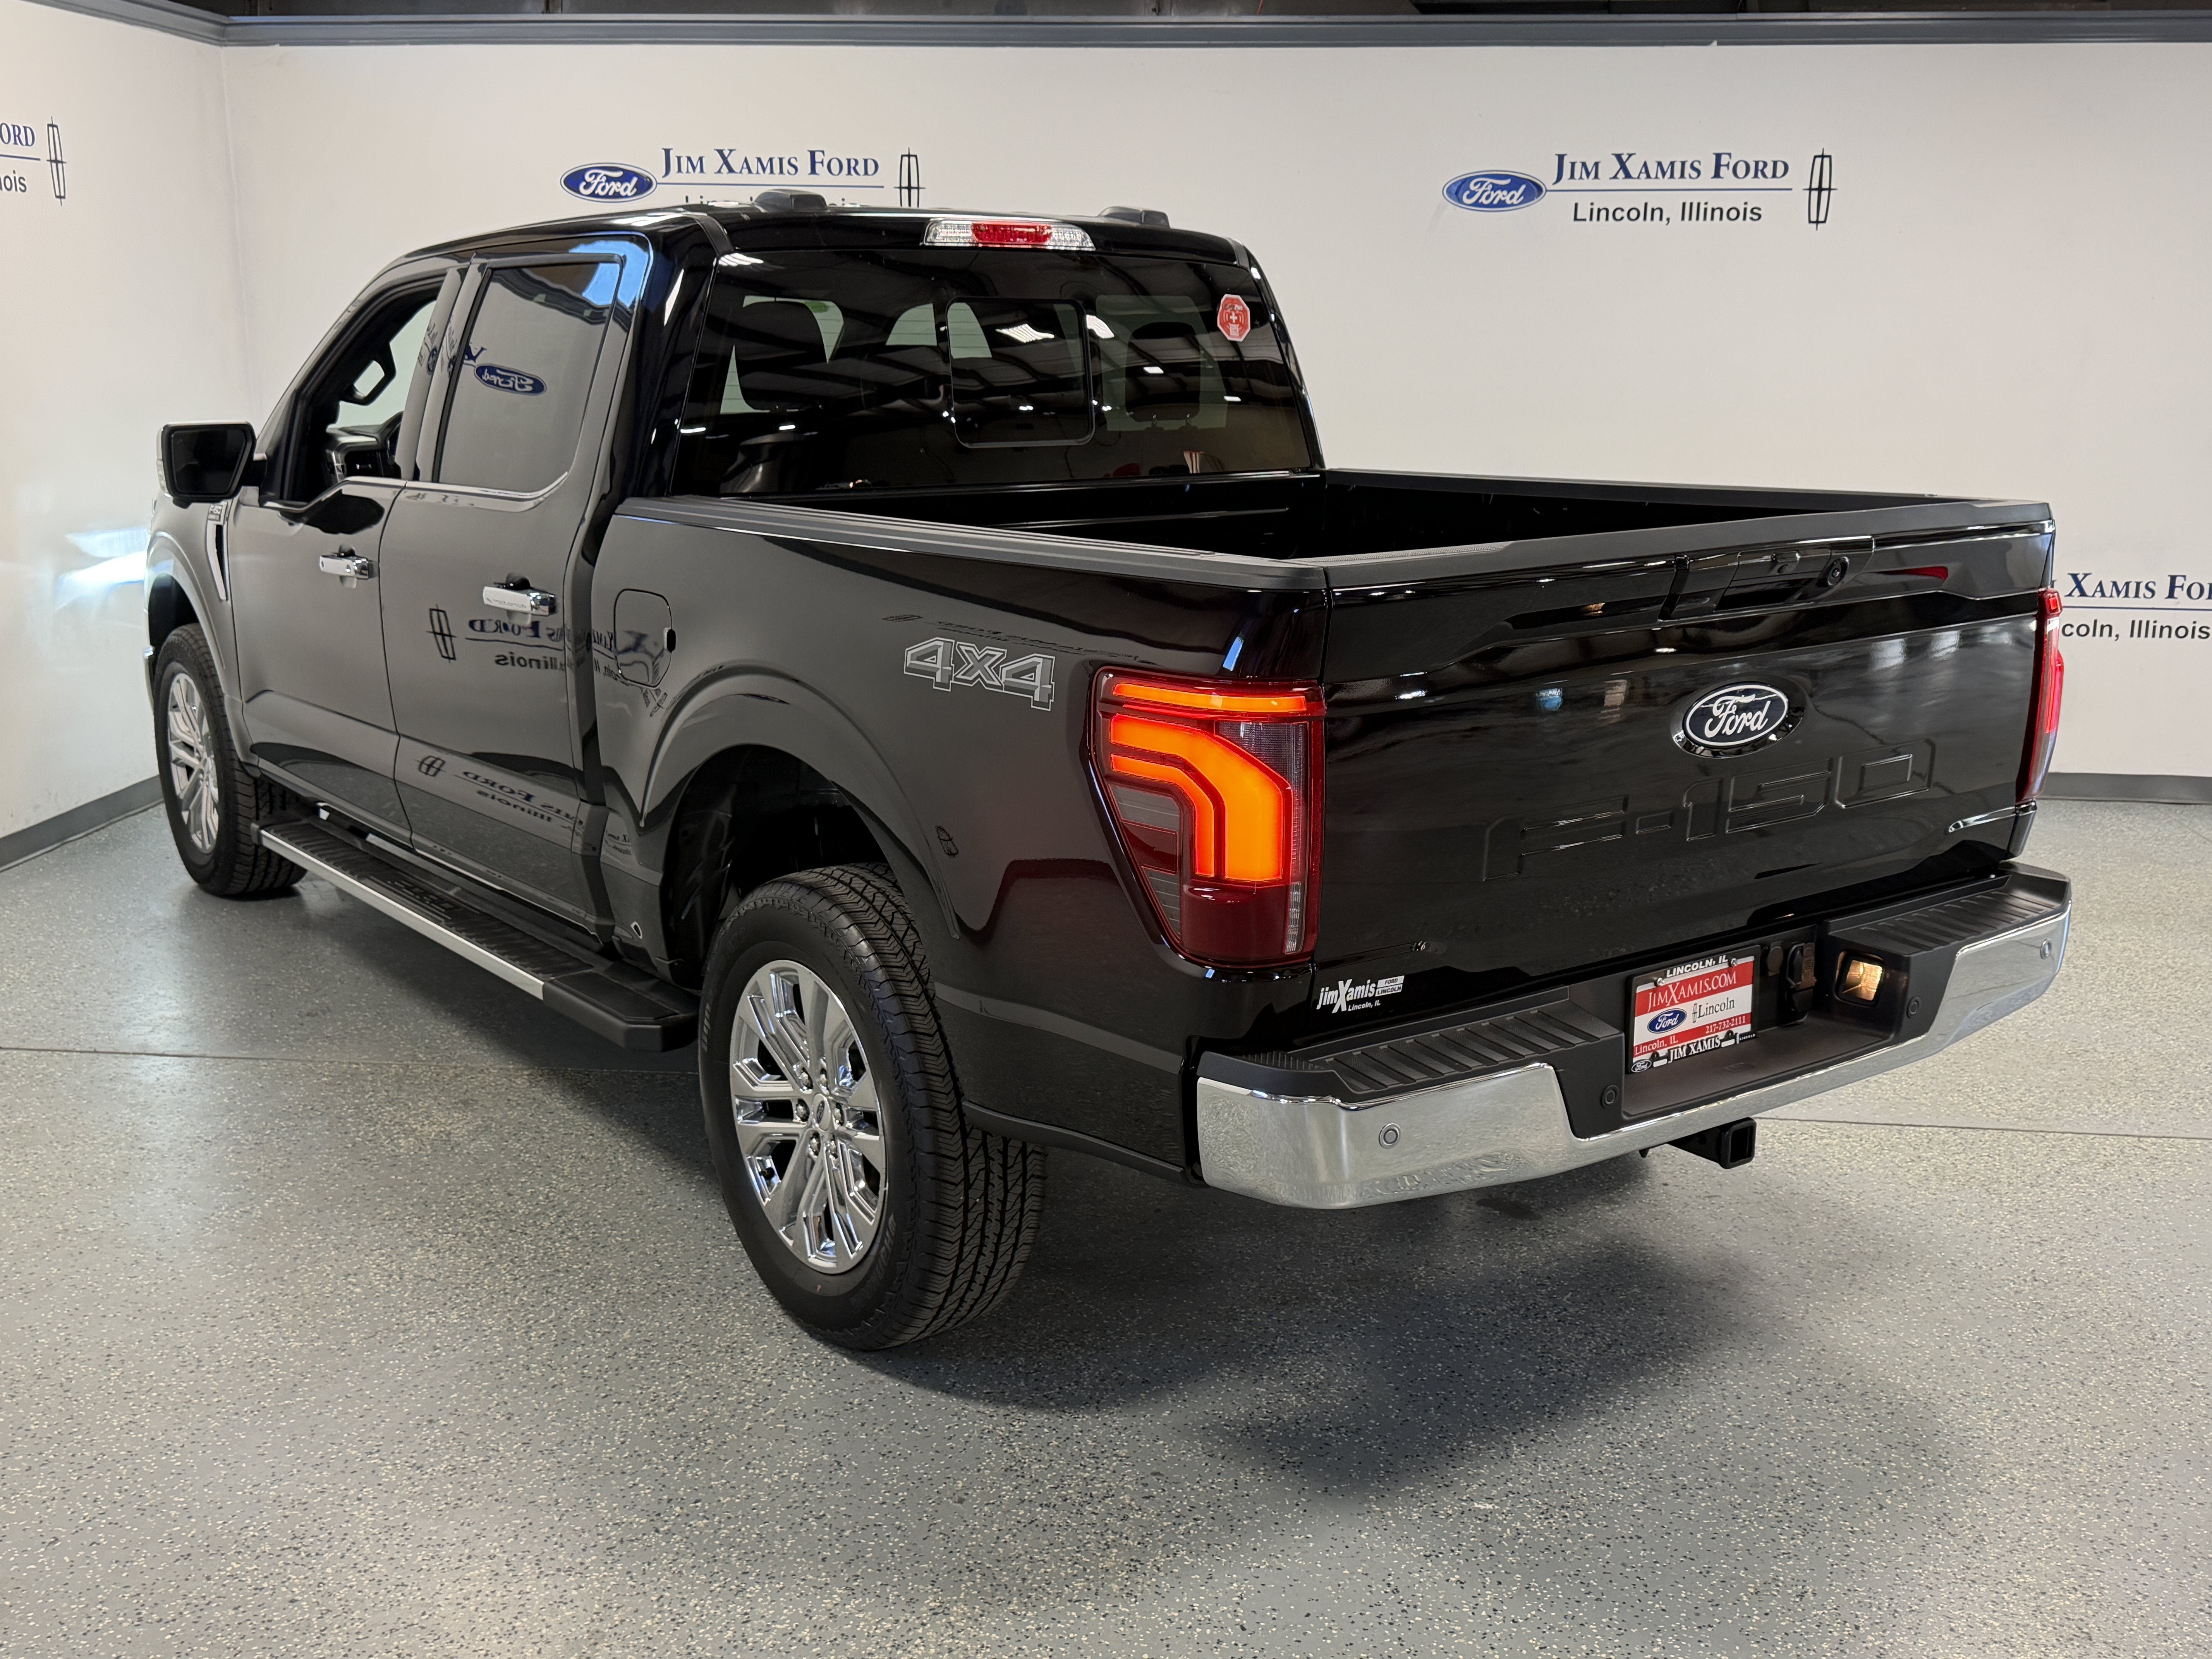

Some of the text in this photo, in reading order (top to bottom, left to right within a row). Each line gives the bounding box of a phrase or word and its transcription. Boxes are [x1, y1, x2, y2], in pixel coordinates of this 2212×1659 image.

[661, 148, 879, 178] JIM XAMIS FORD
[1552, 152, 1790, 185] JIM XAMIS FORD
[579, 169, 638, 197] Ford
[1462, 177, 1527, 204] Ford
[1573, 201, 1762, 225] Lincoln, Illinois
[2064, 572, 2156, 599] XAMIS
[2130, 620, 2210, 640] Illinois
[1704, 694, 1771, 738] Ford
[1482, 738, 1936, 882] F-150
[1666, 955, 1728, 977] LINCOLN, IL
[1377, 986, 1401, 995] LINCOLN
[1647, 971, 1737, 1012] JIMXAMIS.COM
[1348, 1001, 1373, 1012] Lincoln,
[1697, 997, 1735, 1018] Lincoln
[1655, 1012, 1680, 1030] Ford
[1705, 1015, 1746, 1034] 217-732-2111
[1668, 1036, 1721, 1063] JIM XAMIS
[1670, 1035, 1678, 1045] IL
